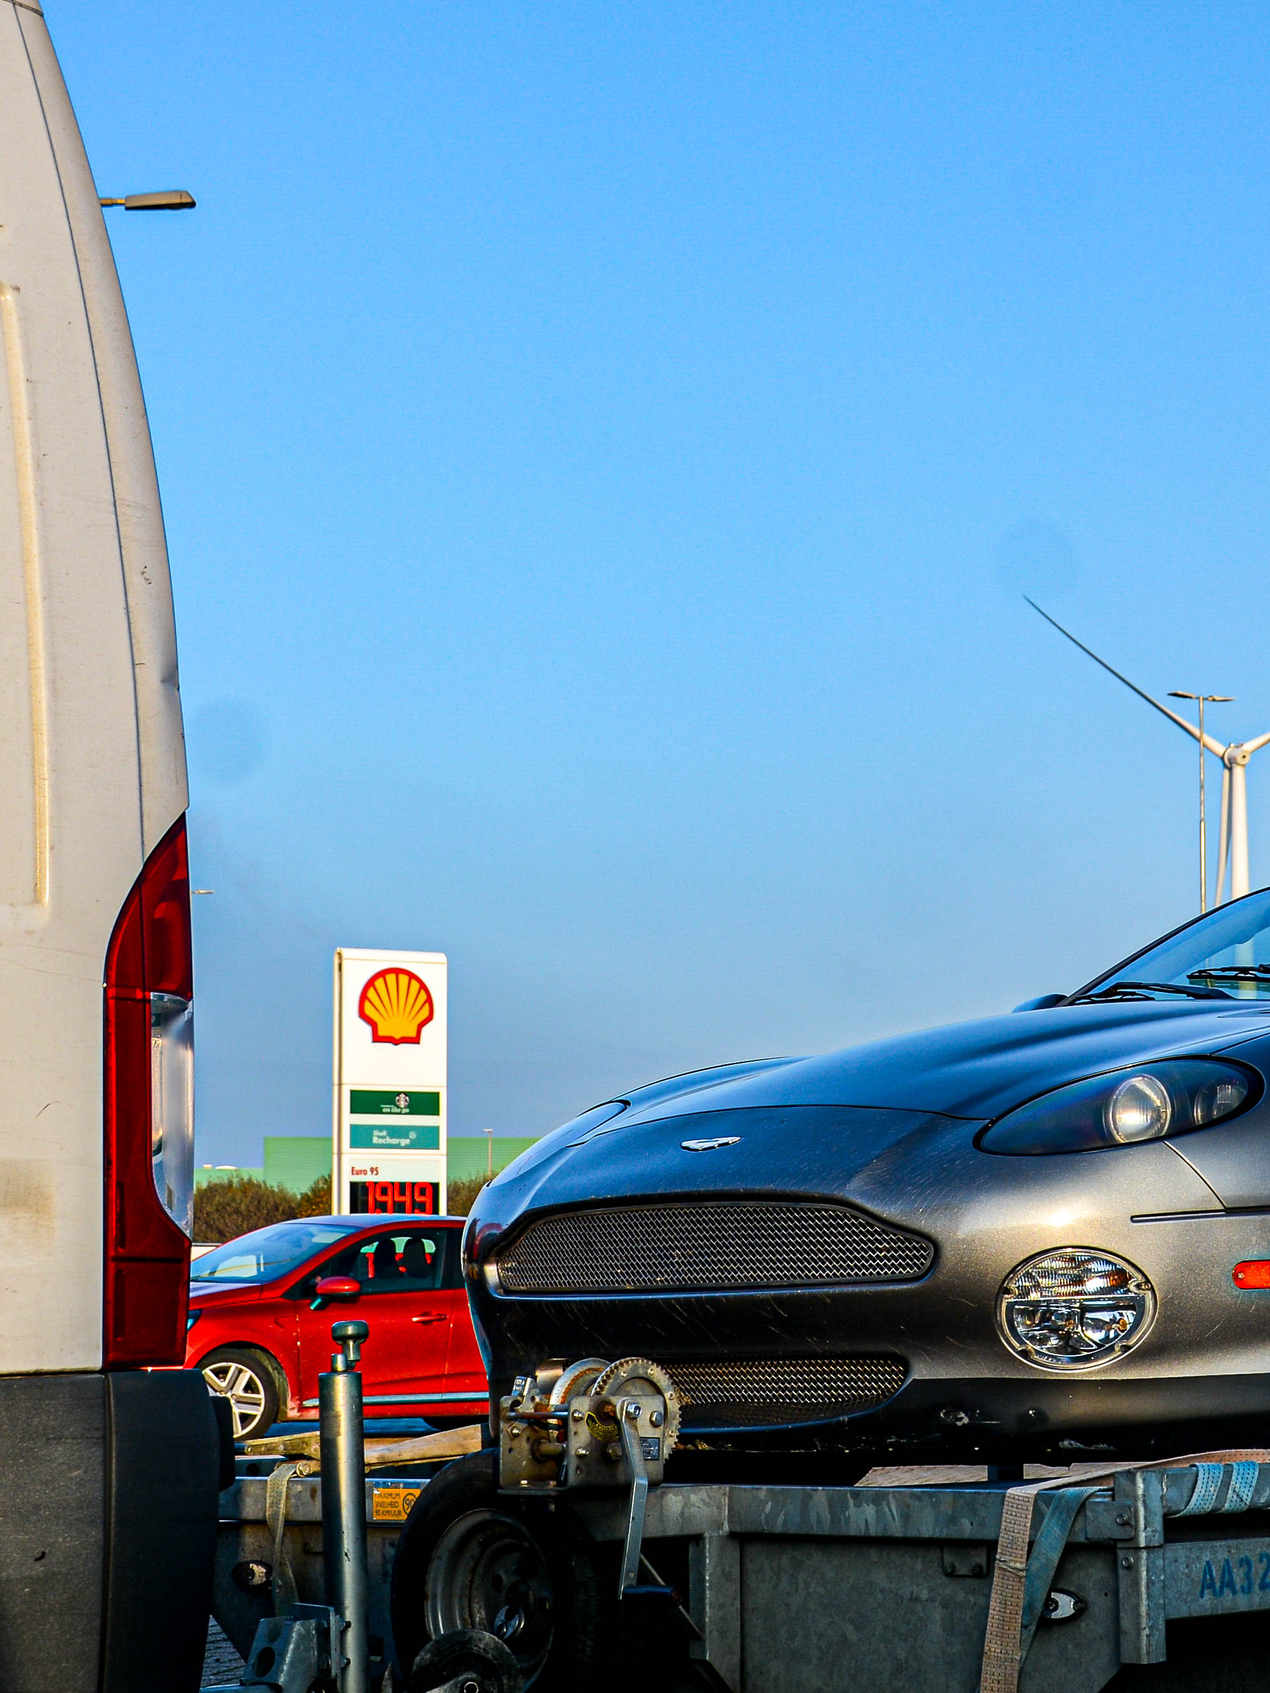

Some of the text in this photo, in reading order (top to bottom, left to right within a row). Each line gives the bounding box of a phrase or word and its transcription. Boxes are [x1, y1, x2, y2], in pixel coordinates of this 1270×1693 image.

[372, 1136, 410, 1147] Recharge
[351, 1167, 379, 1176] Euro 95
